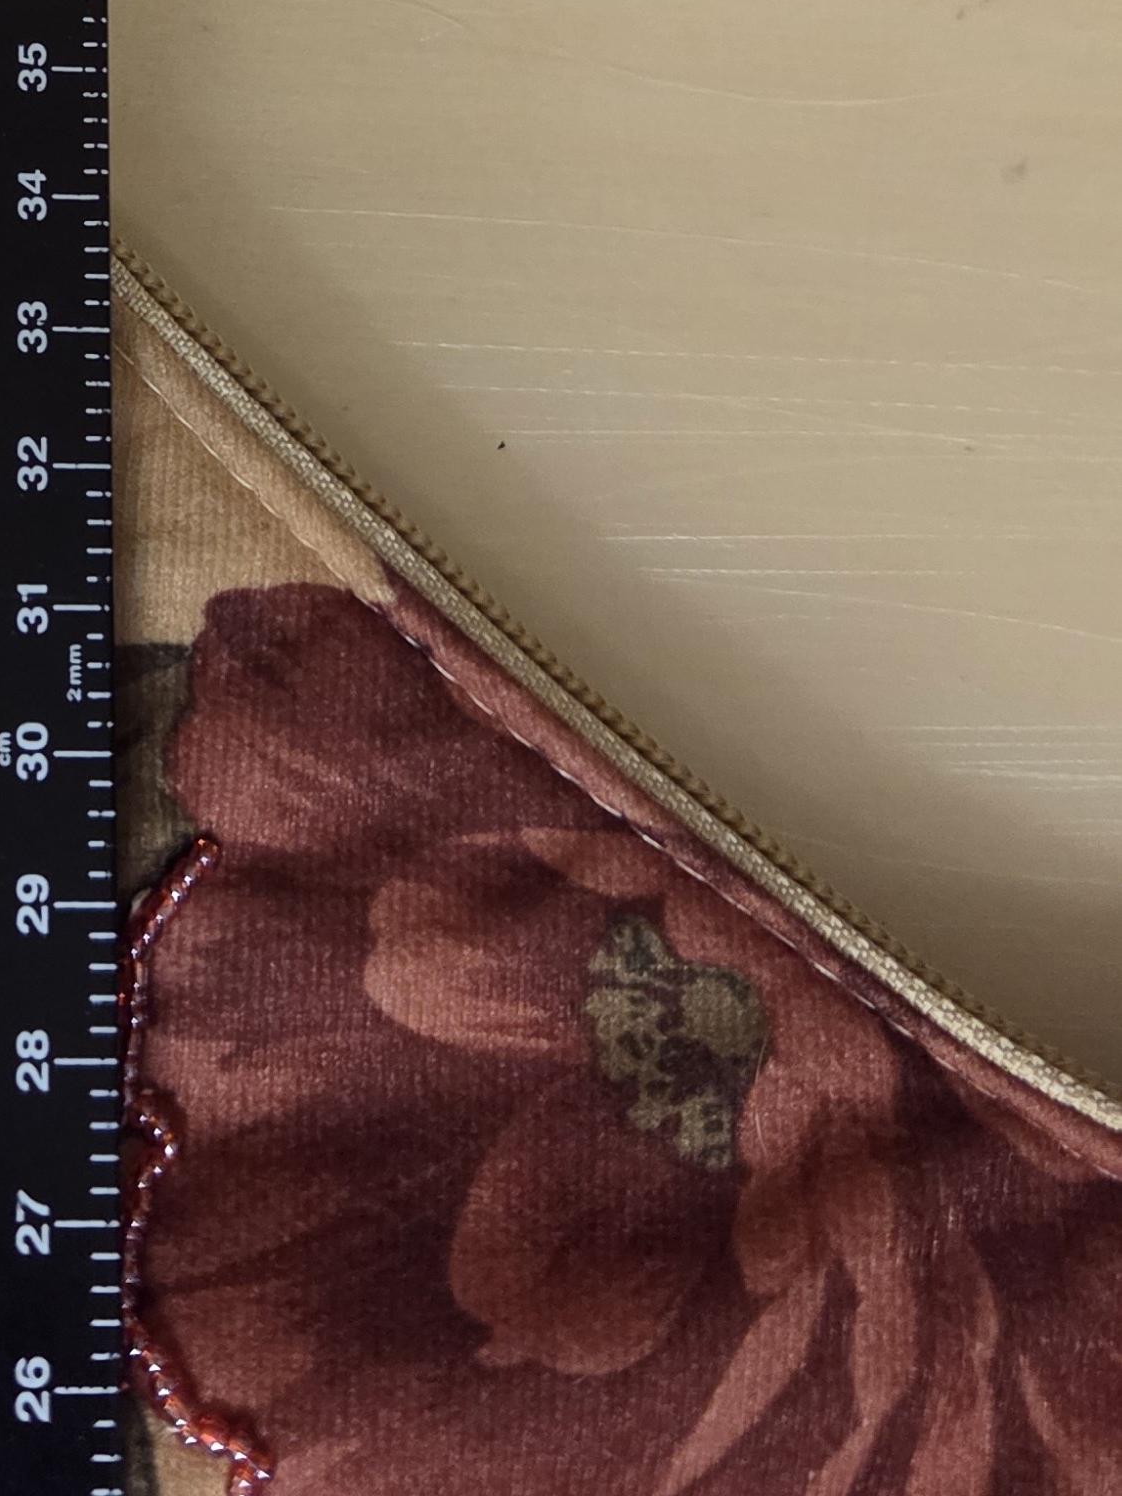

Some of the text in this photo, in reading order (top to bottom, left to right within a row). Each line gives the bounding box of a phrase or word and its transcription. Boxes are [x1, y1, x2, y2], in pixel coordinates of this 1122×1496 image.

[18, 43, 46, 91] 35
[18, 170, 47, 220] 34
[18, 302, 47, 353] 33
[18, 437, 47, 490] 32
[17, 585, 48, 633] 31
[0, 733, 10, 766] cm
[16, 723, 48, 780] 30
[16, 874, 49, 934] 29
[16, 1030, 49, 1091] 28
[16, 1190, 49, 1254] 27
[15, 1357, 50, 1422] 26
